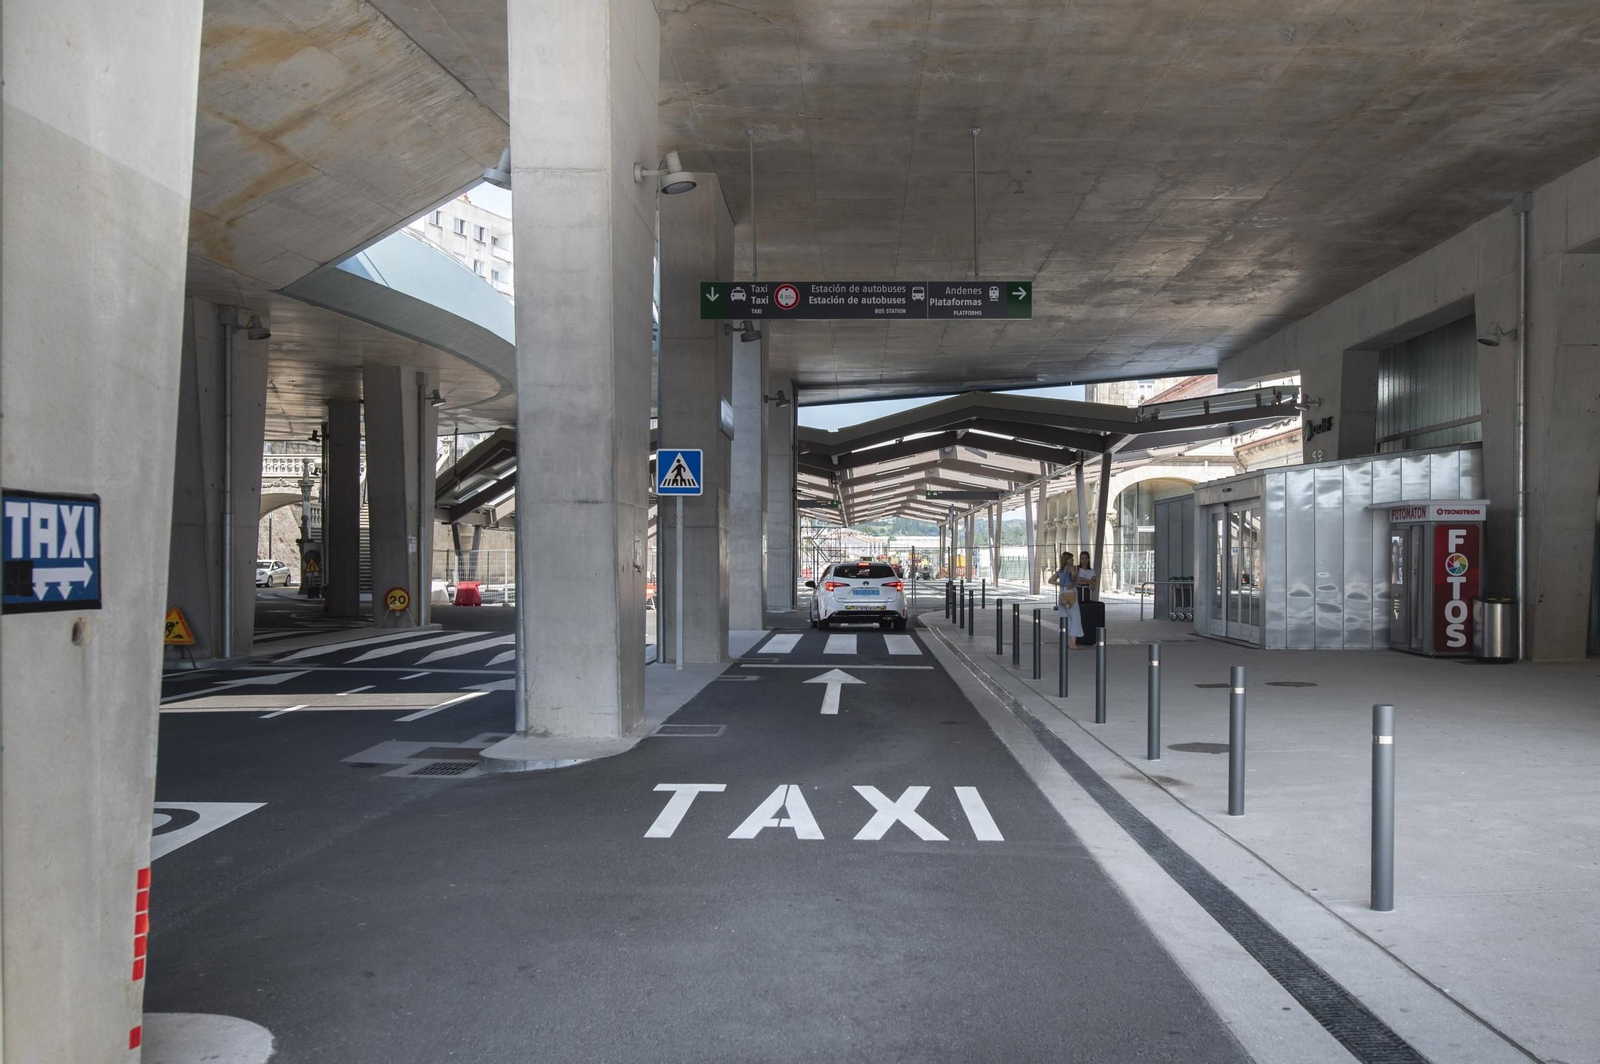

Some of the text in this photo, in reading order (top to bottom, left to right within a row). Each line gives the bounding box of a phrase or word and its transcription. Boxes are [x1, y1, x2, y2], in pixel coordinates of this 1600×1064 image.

[751, 284, 768, 293] Taxi
[811, 284, 906, 293] Estación de autobuses
[945, 286, 982, 295] Andenes
[751, 296, 769, 305] Taxi
[809, 295, 906, 304] Estación de autobuses
[930, 298, 982, 306] Plataformas
[1391, 506, 1427, 520] FOTOMATON
[5, 501, 94, 559] TAXI
[1444, 529, 1468, 648] FOTOS
[389, 595, 406, 605] 20
[643, 783, 1005, 842] TAXI
